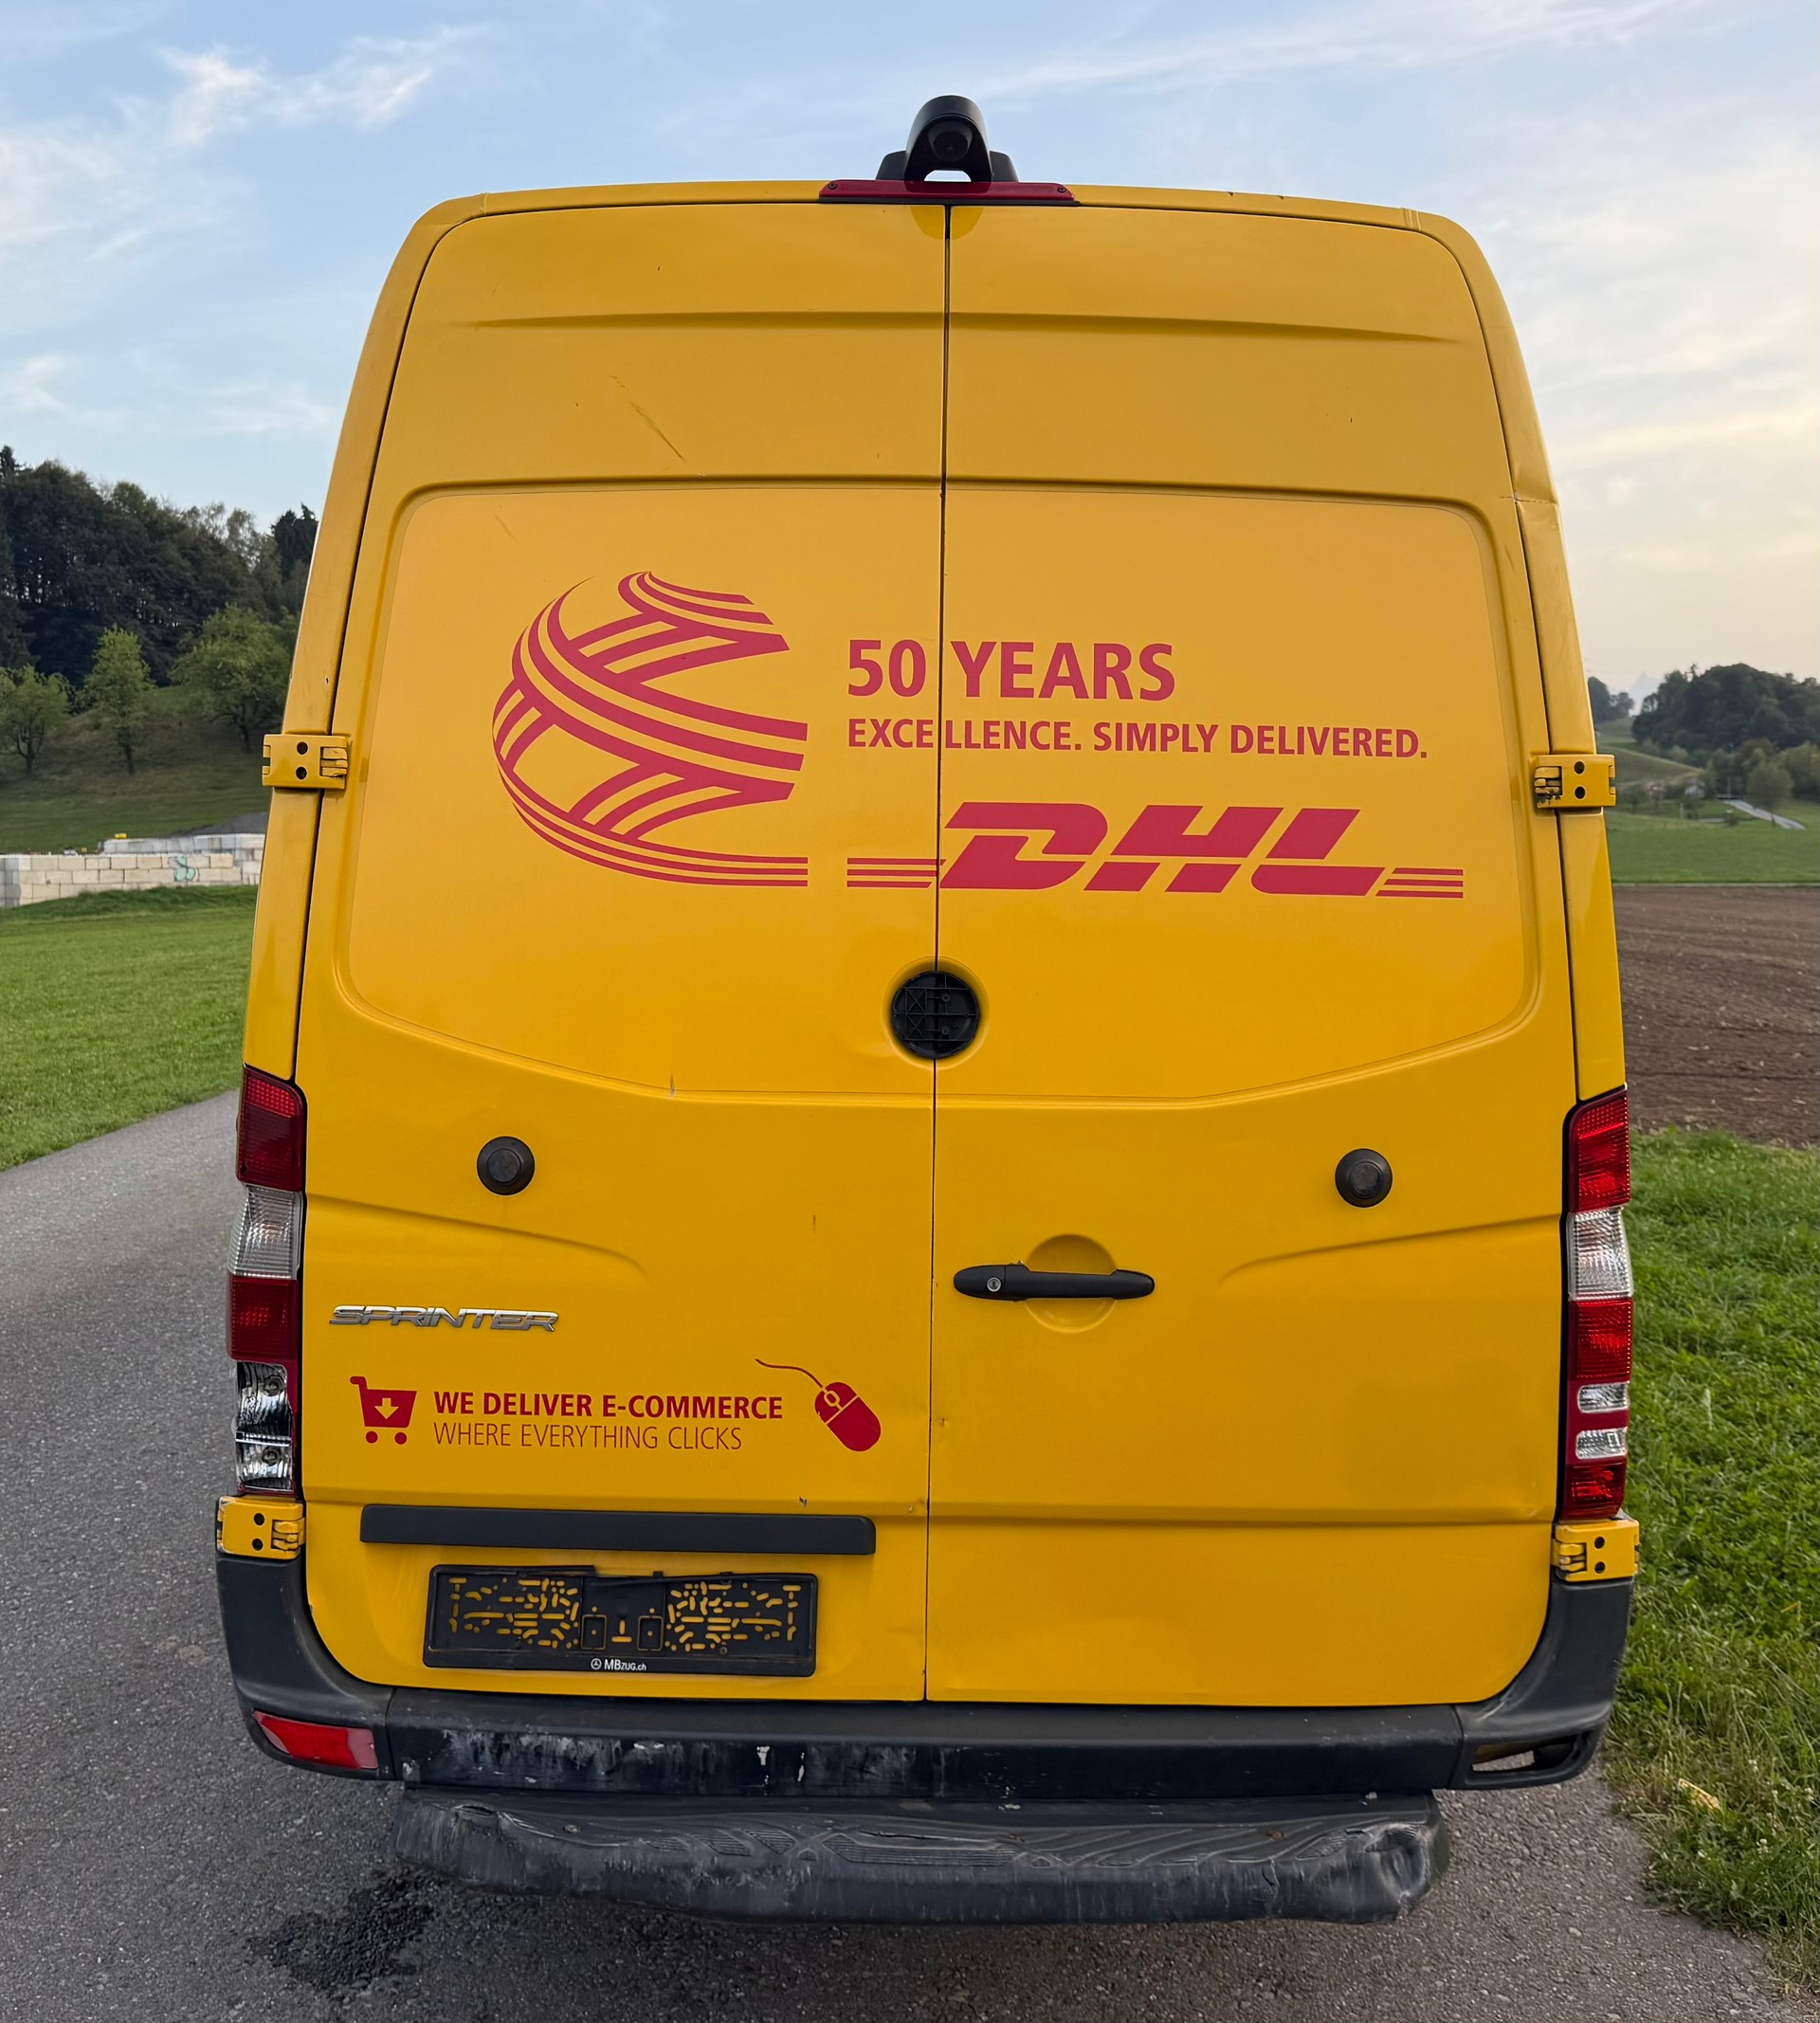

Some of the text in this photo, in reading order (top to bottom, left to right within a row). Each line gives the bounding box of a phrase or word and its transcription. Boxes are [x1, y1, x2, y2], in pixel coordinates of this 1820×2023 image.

[847, 639, 1175, 701] 50 YEARS
[847, 718, 1428, 758] EXCELLENCE. SIMPLY DELIVERED.
[939, 801, 1386, 897] DHL
[329, 1305, 559, 1332] SPRINTER
[433, 1391, 783, 1420] WE DELIVER E-COMMERCE
[433, 1421, 742, 1451] WHERE EVERYTHING CLICKS
